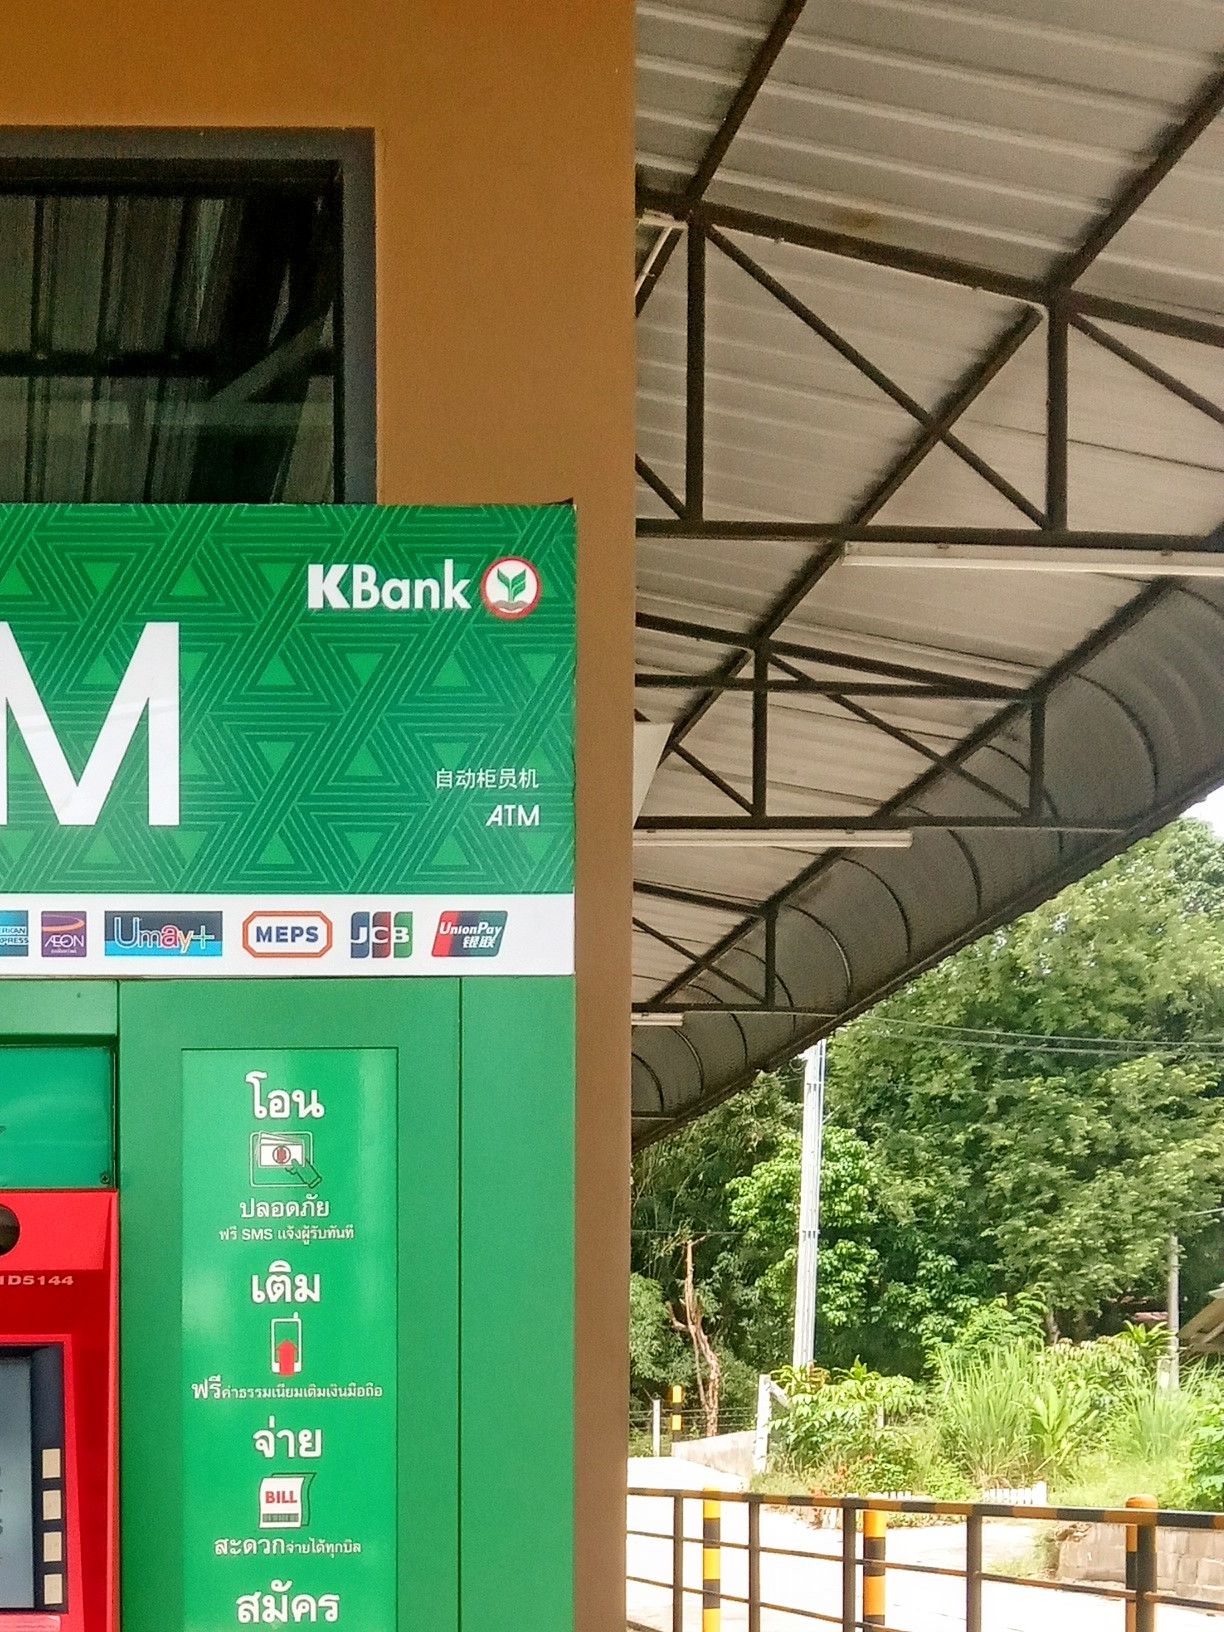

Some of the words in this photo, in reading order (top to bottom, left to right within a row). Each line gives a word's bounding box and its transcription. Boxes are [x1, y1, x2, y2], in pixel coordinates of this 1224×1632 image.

[307, 558, 472, 610] KBank
[435, 767, 540, 790] 自动柜员机
[485, 804, 541, 827] ATM
[113, 915, 216, 954] Umay+
[255, 925, 320, 943] MEPS
[351, 926, 410, 944] JCB
[440, 921, 503, 938] UnionPay
[463, 935, 496, 949] 银联
[245, 1070, 325, 1120] โอน
[240, 1193, 330, 1218] ปลอดภัย
[218, 1225, 238, 1241] ฟรี
[241, 1229, 274, 1241] SMS
[277, 1224, 354, 1246] แจ้งผู้รับทันที
[251, 1260, 321, 1304] เติม
[252, 1415, 323, 1459] จ่าย
[264, 1490, 298, 1504] BILL
[235, 1579, 340, 1625] สมัคร
